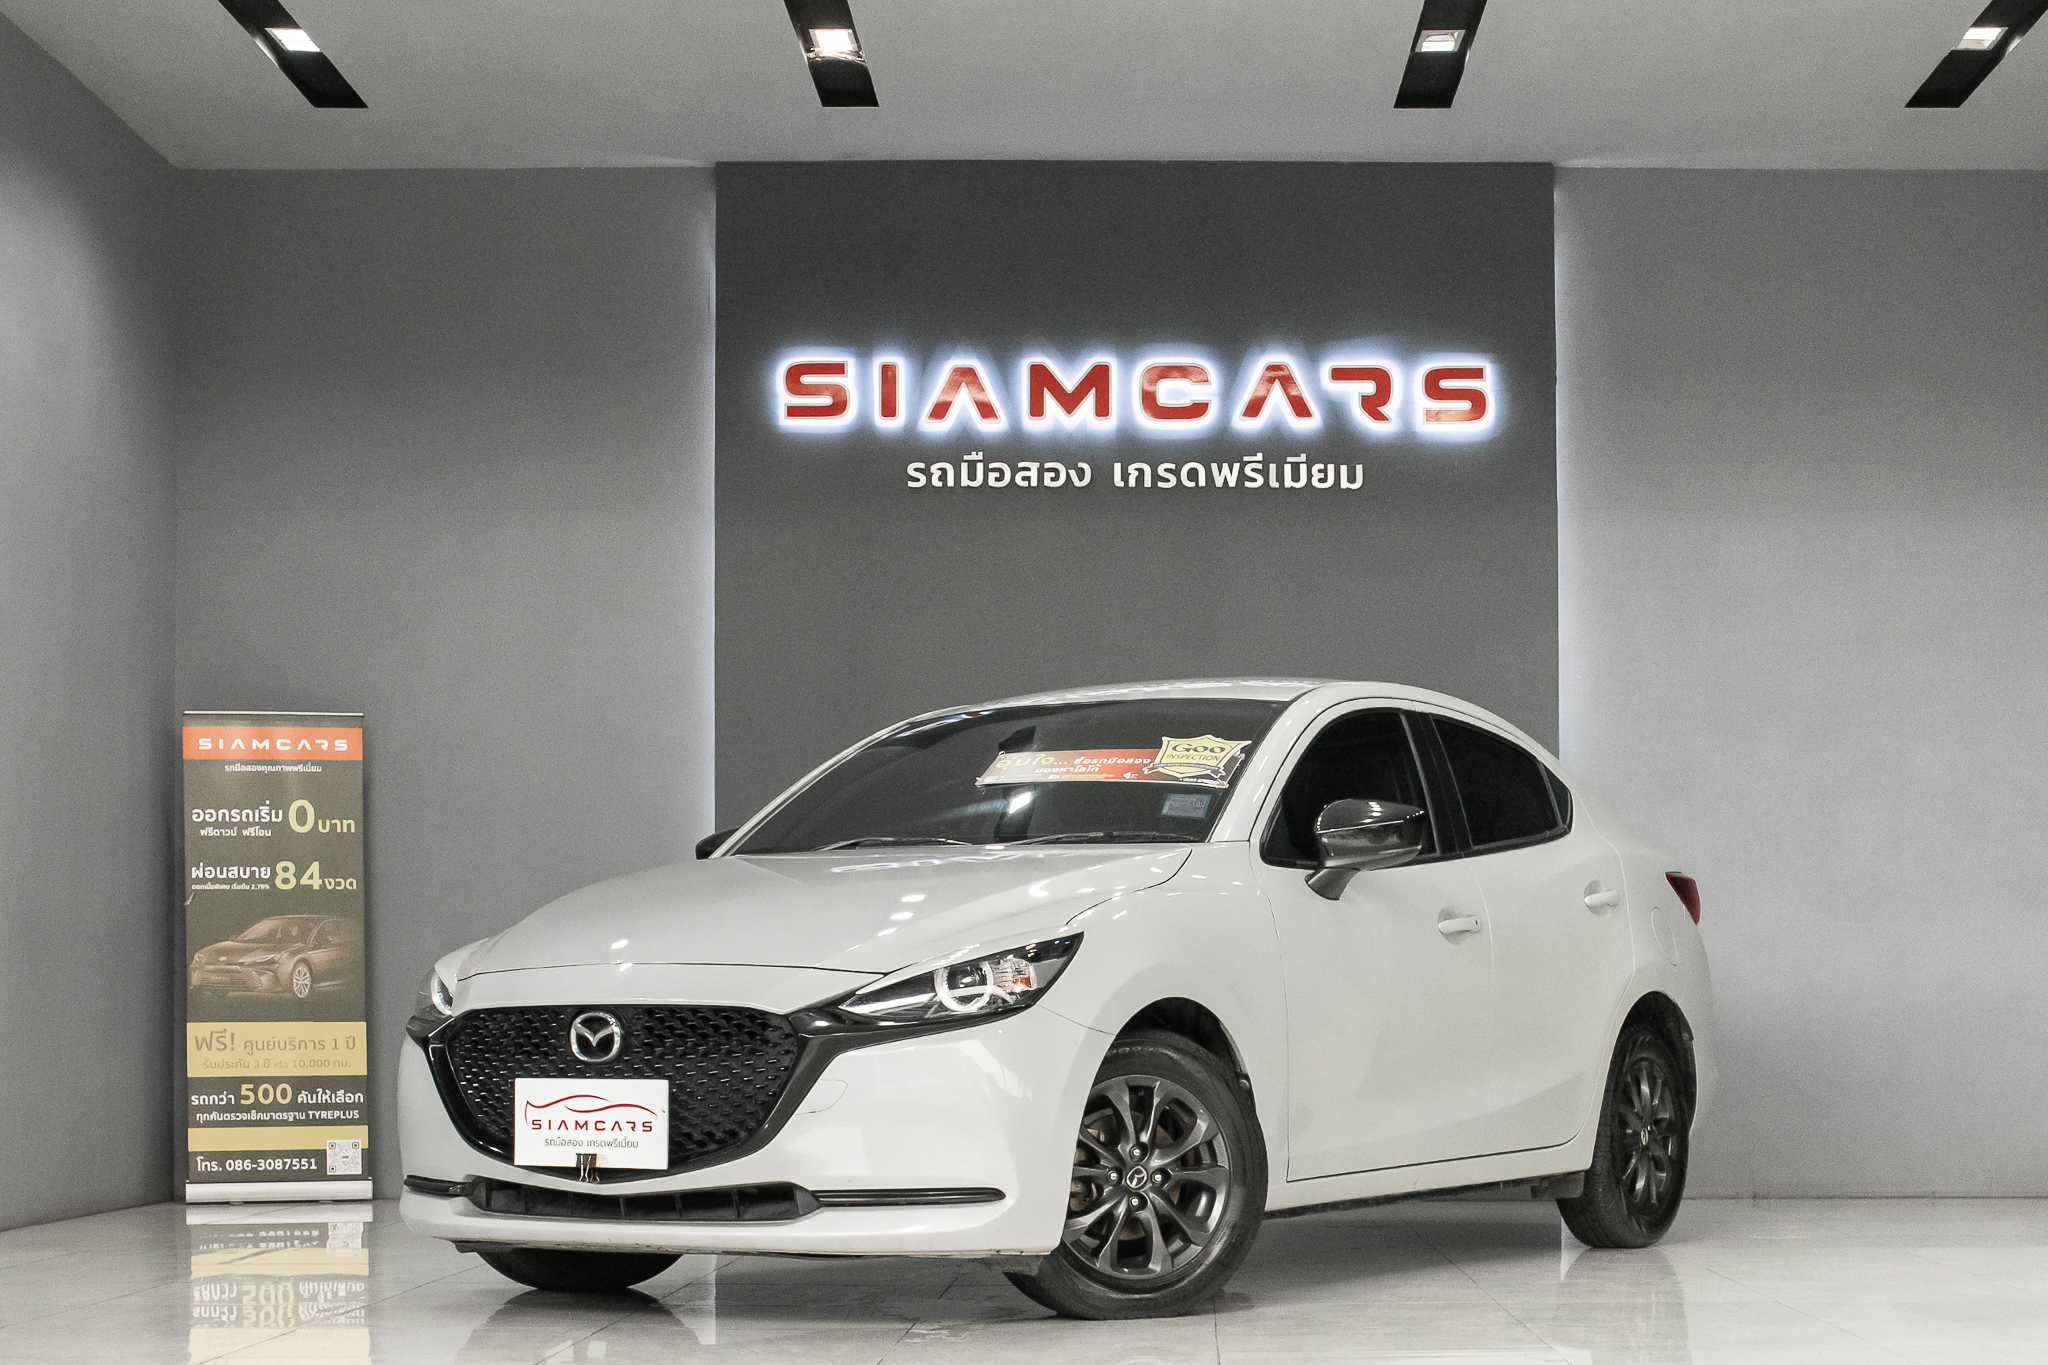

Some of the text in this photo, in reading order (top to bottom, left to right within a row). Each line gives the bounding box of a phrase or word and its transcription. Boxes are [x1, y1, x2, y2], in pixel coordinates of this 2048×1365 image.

[781, 360, 1489, 426] SIAMCARS
[907, 451, 1364, 490] รถมือสอง เกรดพรีเมียม
[198, 737, 348, 751] SIAMCARS
[1165, 753, 1221, 762] INSPECTION
[1034, 764, 1102, 774] มองหาโลโก้
[191, 800, 284, 823] ออกรถเริ่ม
[318, 819, 356, 834] บาท
[200, 825, 272, 837] ฟรีดาวน์ ฟรีโอน
[191, 860, 357, 890] ผ่อนสบาย 84 งวด
[194, 1028, 357, 1056] ฟรี! ศูนย์บริการ 1 ปี
[203, 1057, 251, 1069] รับประกัน
[253, 1059, 260, 1069] 3
[262, 1057, 271, 1069] ปี
[292, 1058, 331, 1070] 10,000
[191, 1083, 364, 1105] รถกว่า 500 คันให้เลือก
[196, 1109, 360, 1123] ทุกคันตรวจเช็คมาตรฐาน TYREPLUS
[531, 1119, 653, 1133] SIAMCARS
[544, 1136, 584, 1148] รถมือสอง
[196, 1156, 318, 1172] โทร. 086-3087551
